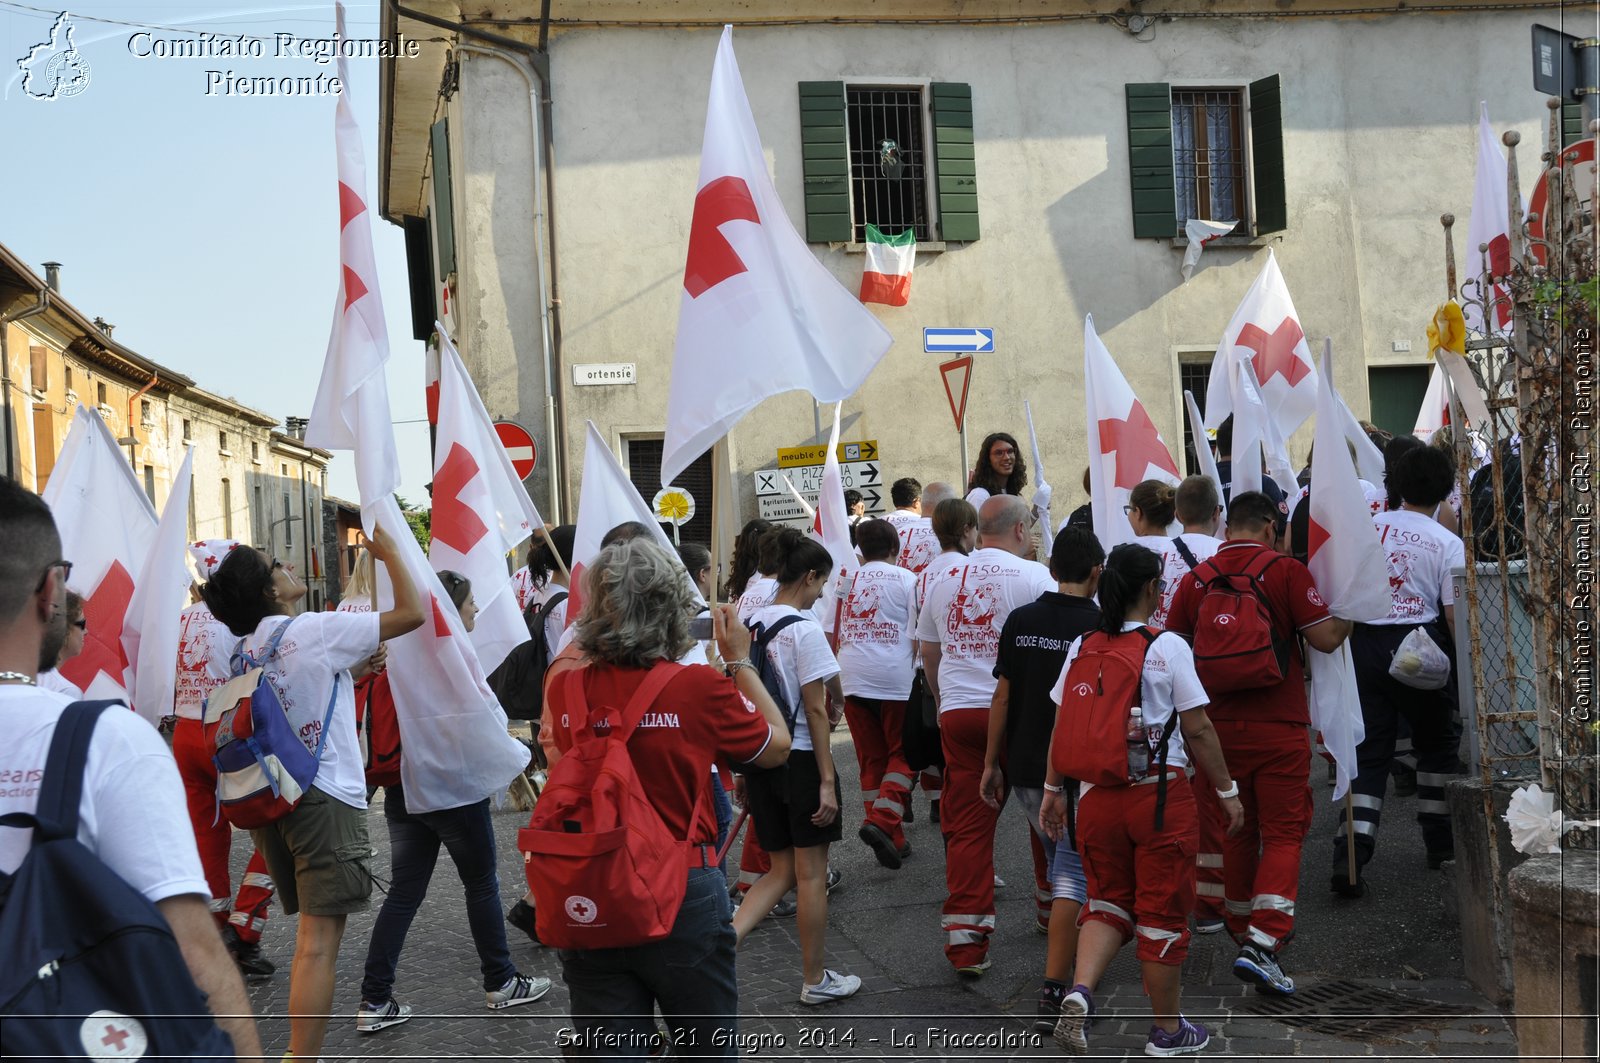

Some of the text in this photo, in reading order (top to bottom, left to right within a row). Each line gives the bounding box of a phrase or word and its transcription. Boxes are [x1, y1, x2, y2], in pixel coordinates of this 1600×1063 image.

[587, 369, 631, 379] ortensie
[801, 464, 851, 479] PIZZIA
[802, 479, 816, 490] AL
[762, 498, 795, 506] Agriturismo
[773, 508, 804, 516] VALENTINA
[1390, 528, 1420, 546] 150
[861, 571, 883, 583] 150
[970, 564, 1000, 581] 150
[744, 596, 763, 611] 150
[1015, 635, 1037, 647] CROCE
[1038, 637, 1060, 650] ROSSA
[637, 712, 680, 728] ALIANA
[0, 768, 43, 783] ears
